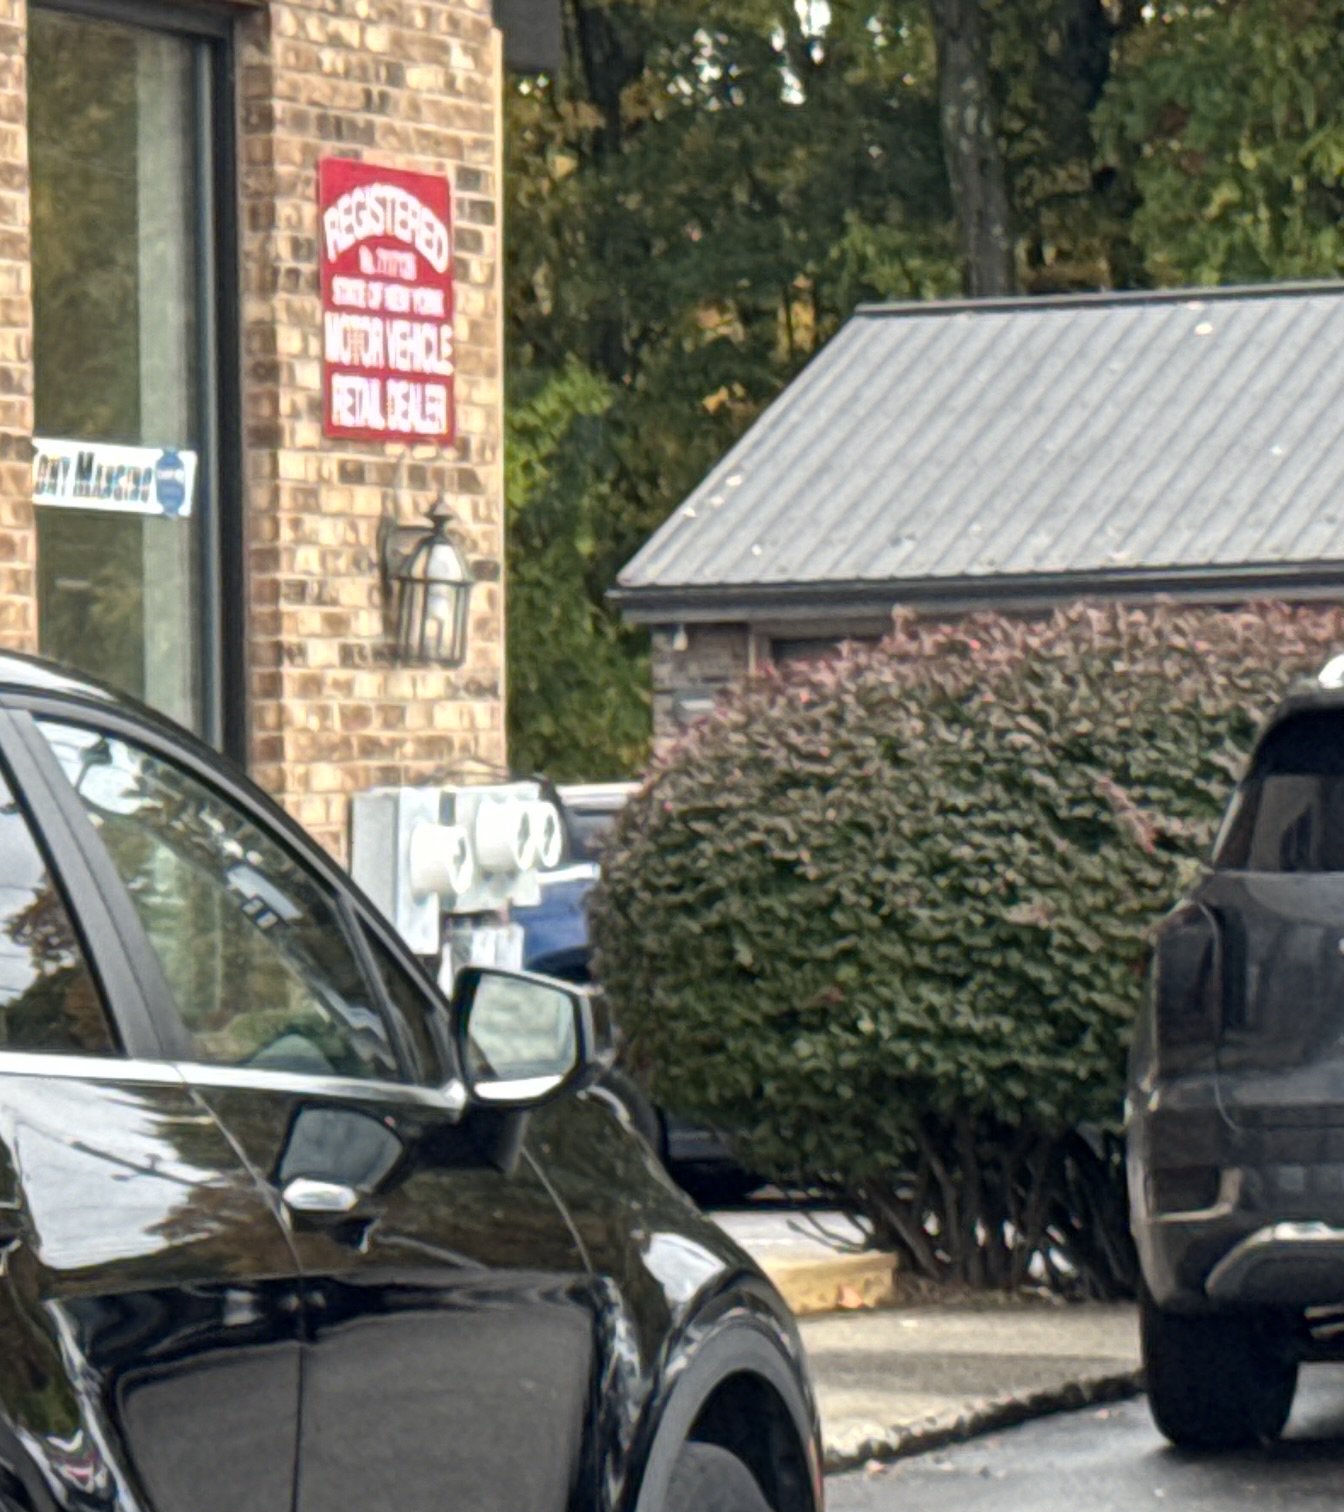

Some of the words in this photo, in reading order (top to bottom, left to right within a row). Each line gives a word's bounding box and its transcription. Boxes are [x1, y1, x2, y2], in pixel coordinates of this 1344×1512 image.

[324, 183, 449, 273] REGISTERED
[324, 312, 385, 368] MOTOR
[385, 317, 453, 376] VEHICLE
[331, 372, 385, 430] RETAIL
[386, 378, 447, 434] DEALER
[34, 454, 71, 496] ONY
